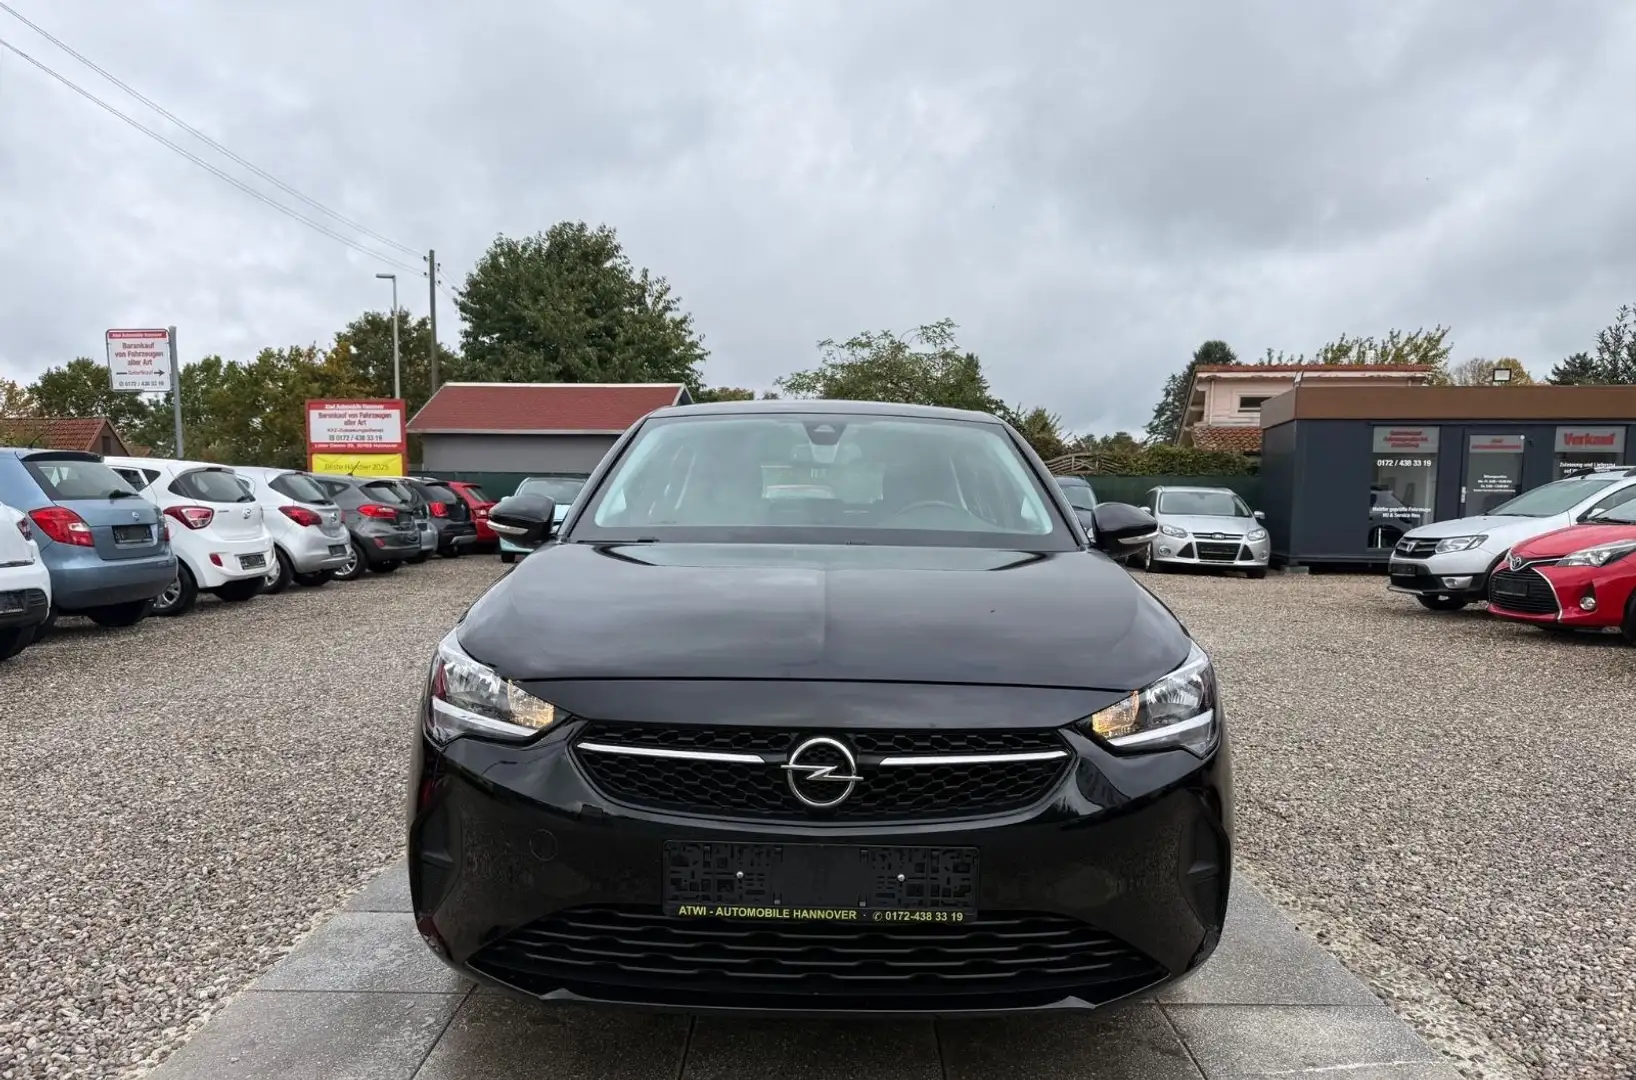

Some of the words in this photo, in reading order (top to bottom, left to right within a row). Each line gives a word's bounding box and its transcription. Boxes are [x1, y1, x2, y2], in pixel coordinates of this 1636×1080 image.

[142, 358, 153, 366] Art
[1564, 432, 1616, 446] Verkauf
[1376, 459, 1394, 467] 0172
[1399, 459, 1412, 467] 438
[1412, 459, 1422, 467] 33
[1423, 459, 1432, 467] 19
[678, 905, 707, 916] ATWI
[715, 906, 791, 918] AUTOMOBILE
[793, 909, 857, 920] HANNOVER
[885, 911, 932, 921] 0172-438
[935, 911, 948, 921] 33
[951, 912, 964, 922] 19
